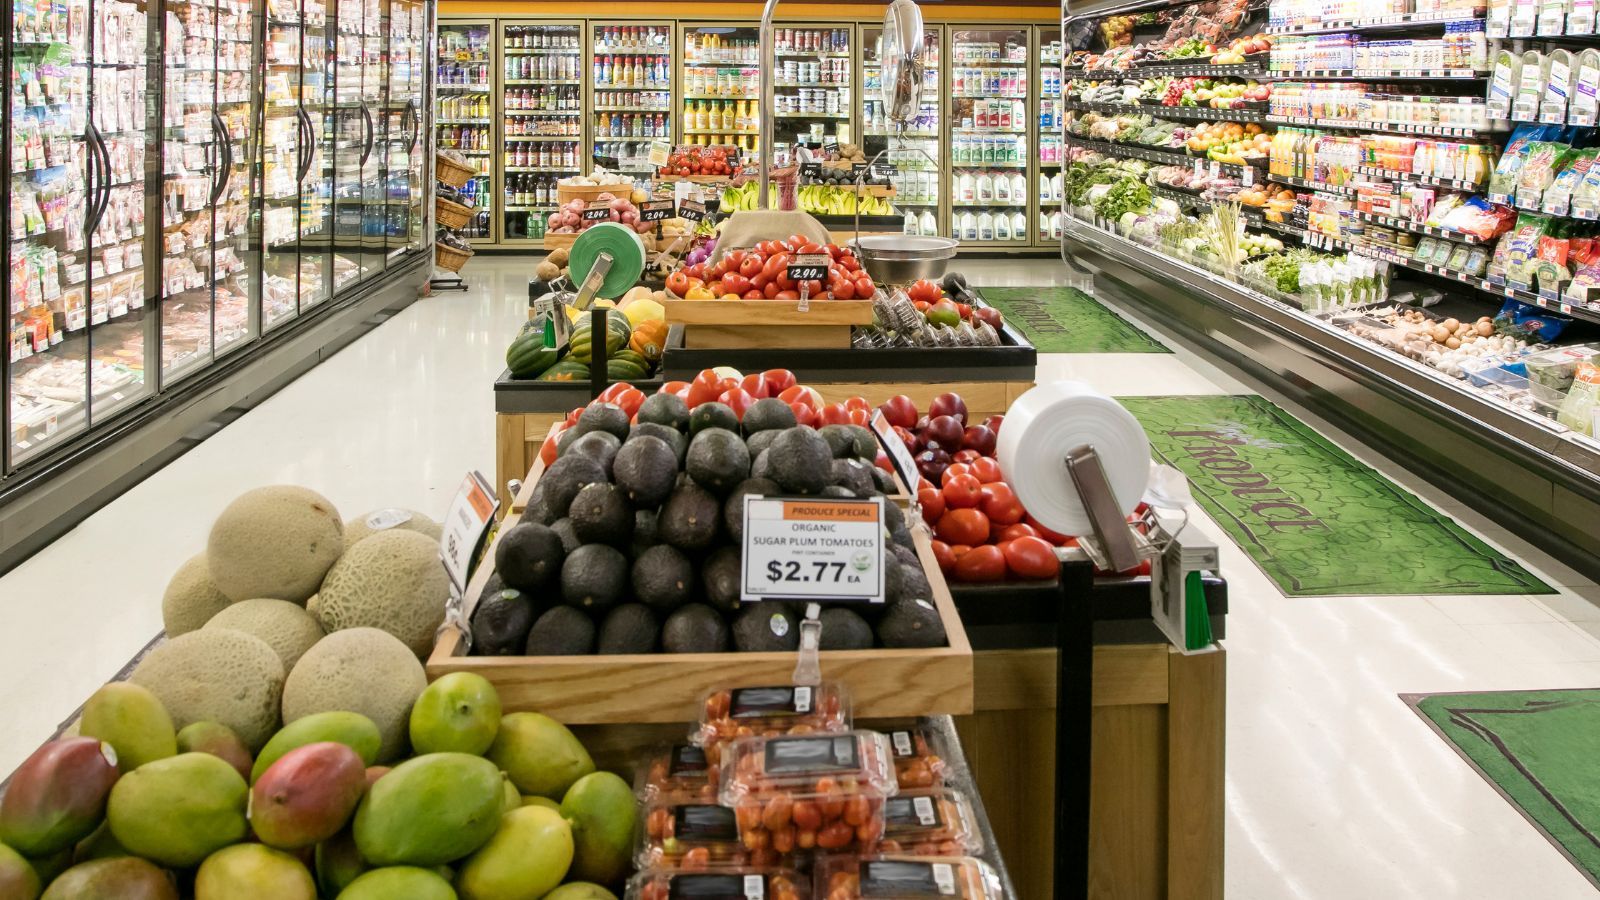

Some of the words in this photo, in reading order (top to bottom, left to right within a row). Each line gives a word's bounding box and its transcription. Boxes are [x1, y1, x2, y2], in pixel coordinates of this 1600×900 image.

[792, 507, 834, 516] PRODUCE
[837, 508, 871, 517] SPECIAL
[792, 523, 836, 532] ORGANIC
[753, 536, 786, 546] SUGAR
[789, 537, 817, 546] PLUM
[820, 538, 874, 548] TOMATOES
[766, 559, 847, 584] $2.77
[847, 575, 861, 583] EA
